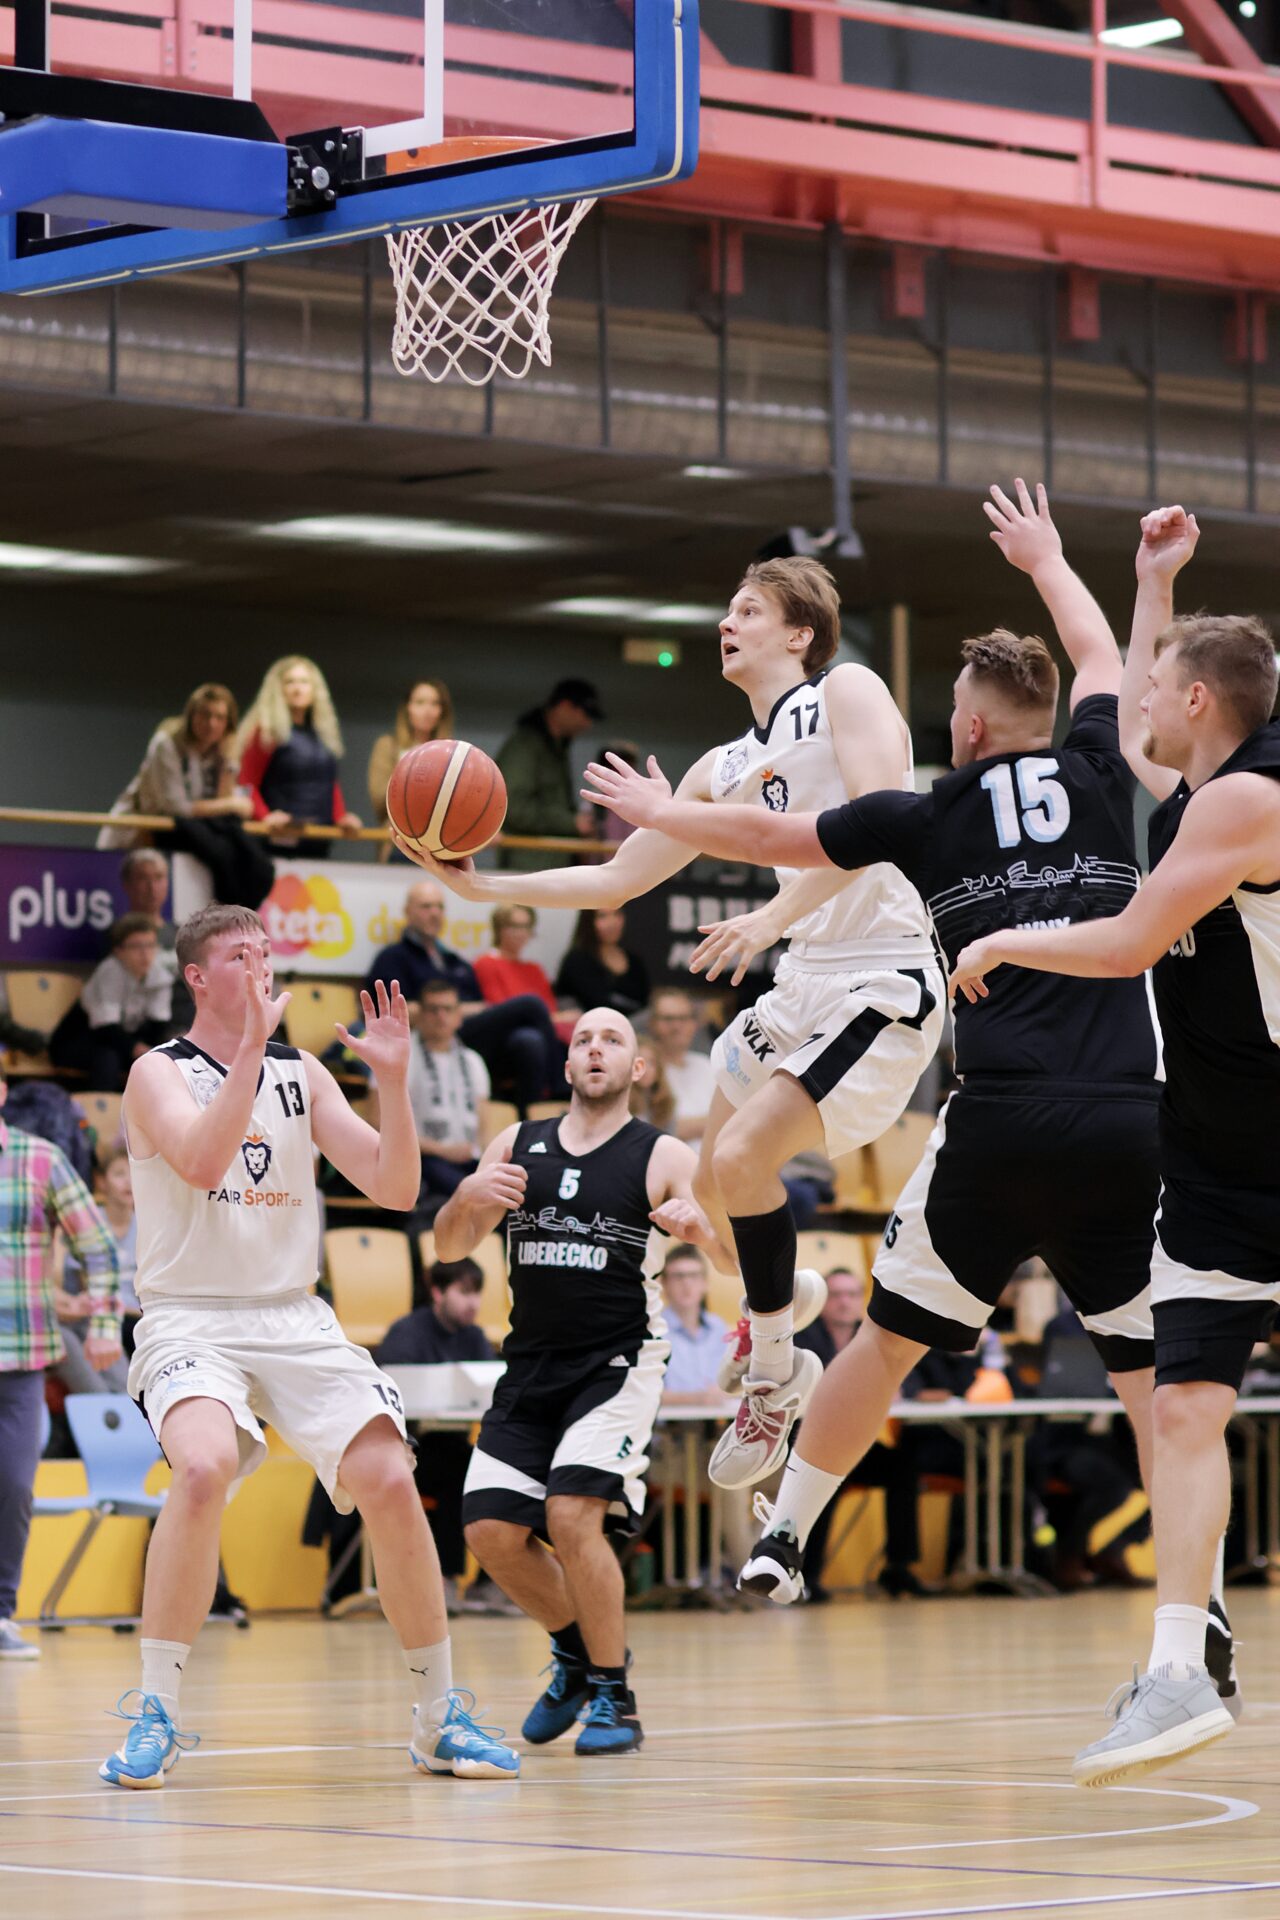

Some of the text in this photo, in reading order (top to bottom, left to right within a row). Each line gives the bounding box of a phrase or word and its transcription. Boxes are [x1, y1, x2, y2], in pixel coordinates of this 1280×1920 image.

[790, 700, 820, 741] 17
[980, 756, 1071, 848] 15
[9, 870, 114, 942] plus
[267, 907, 343, 942] teta
[742, 1019, 776, 1063] VLK
[274, 1080, 306, 1118] 13
[558, 1167, 582, 1200] 5
[518, 1240, 609, 1271] LIBERECKO
[371, 1383, 403, 1415] 13
